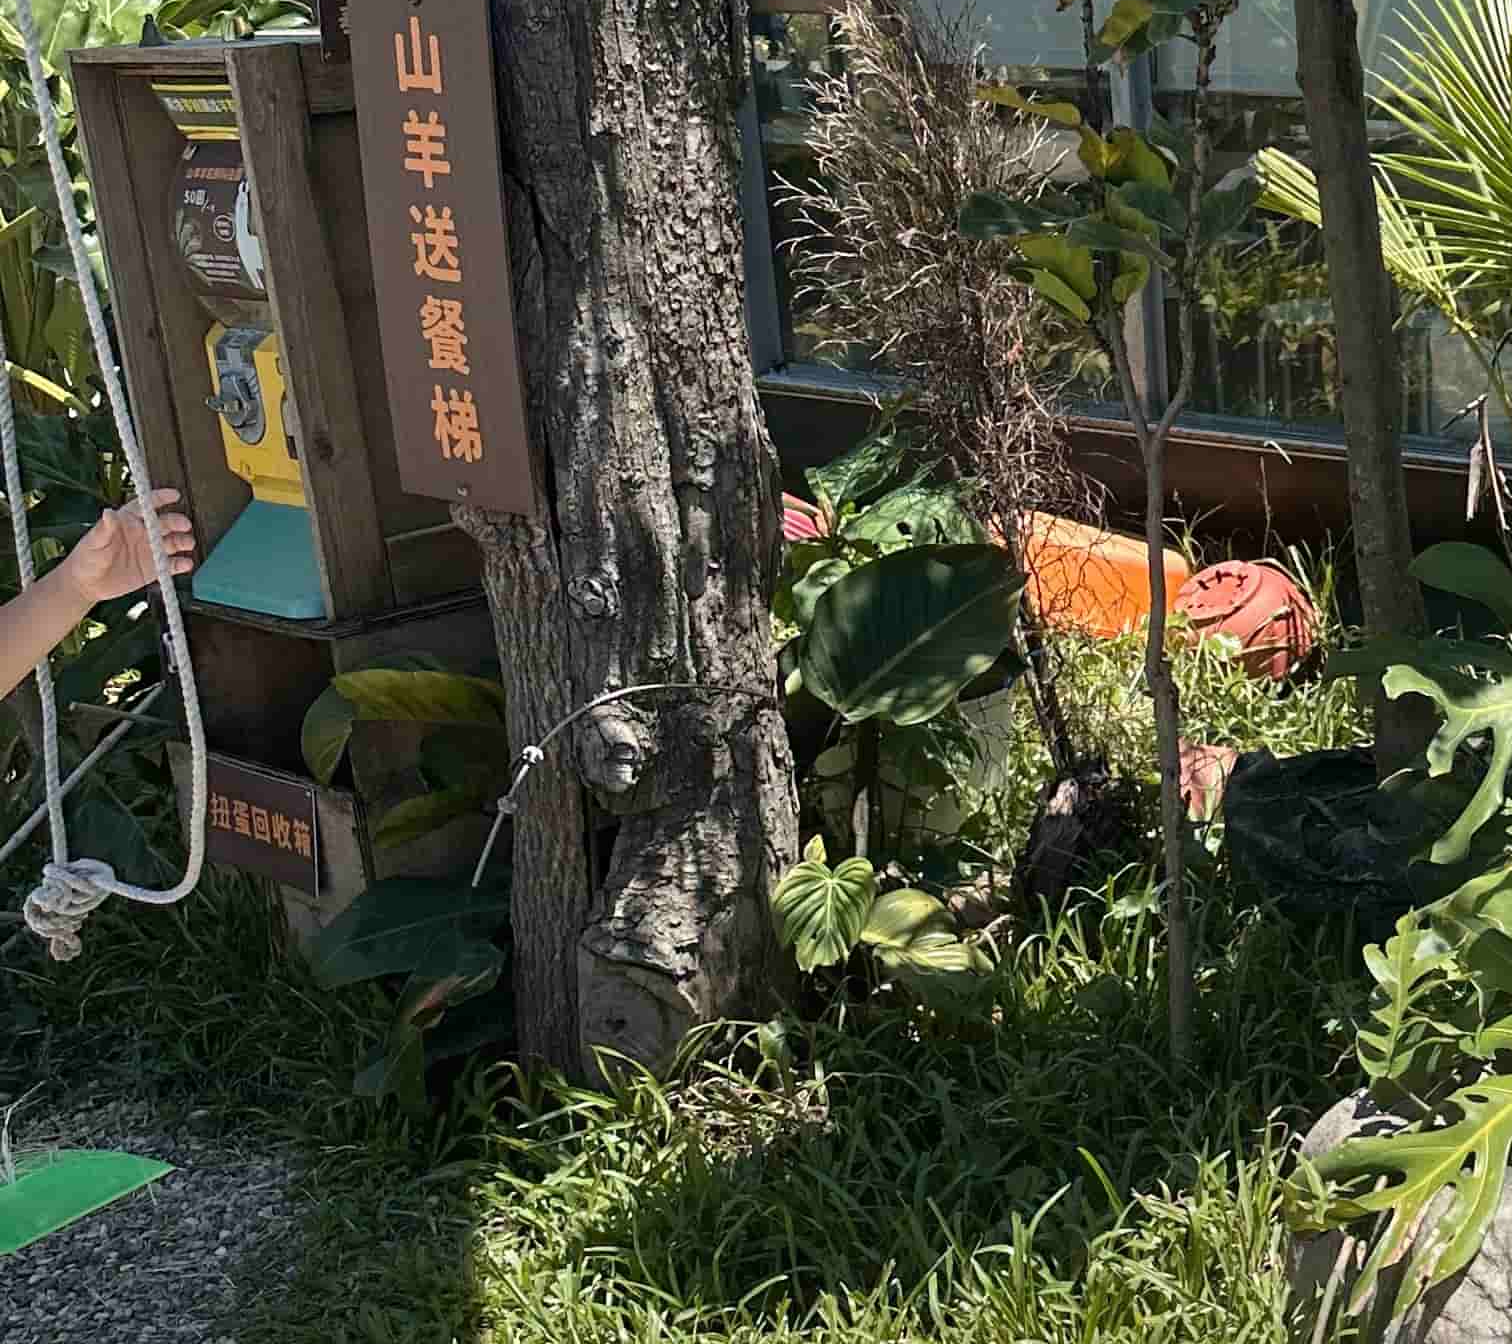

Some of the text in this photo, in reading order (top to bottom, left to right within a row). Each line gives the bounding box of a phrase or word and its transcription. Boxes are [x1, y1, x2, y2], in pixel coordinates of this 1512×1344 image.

[394, 15, 483, 464] 山羊送餐梯
[208, 791, 313, 857] 扭蛋回收箱
